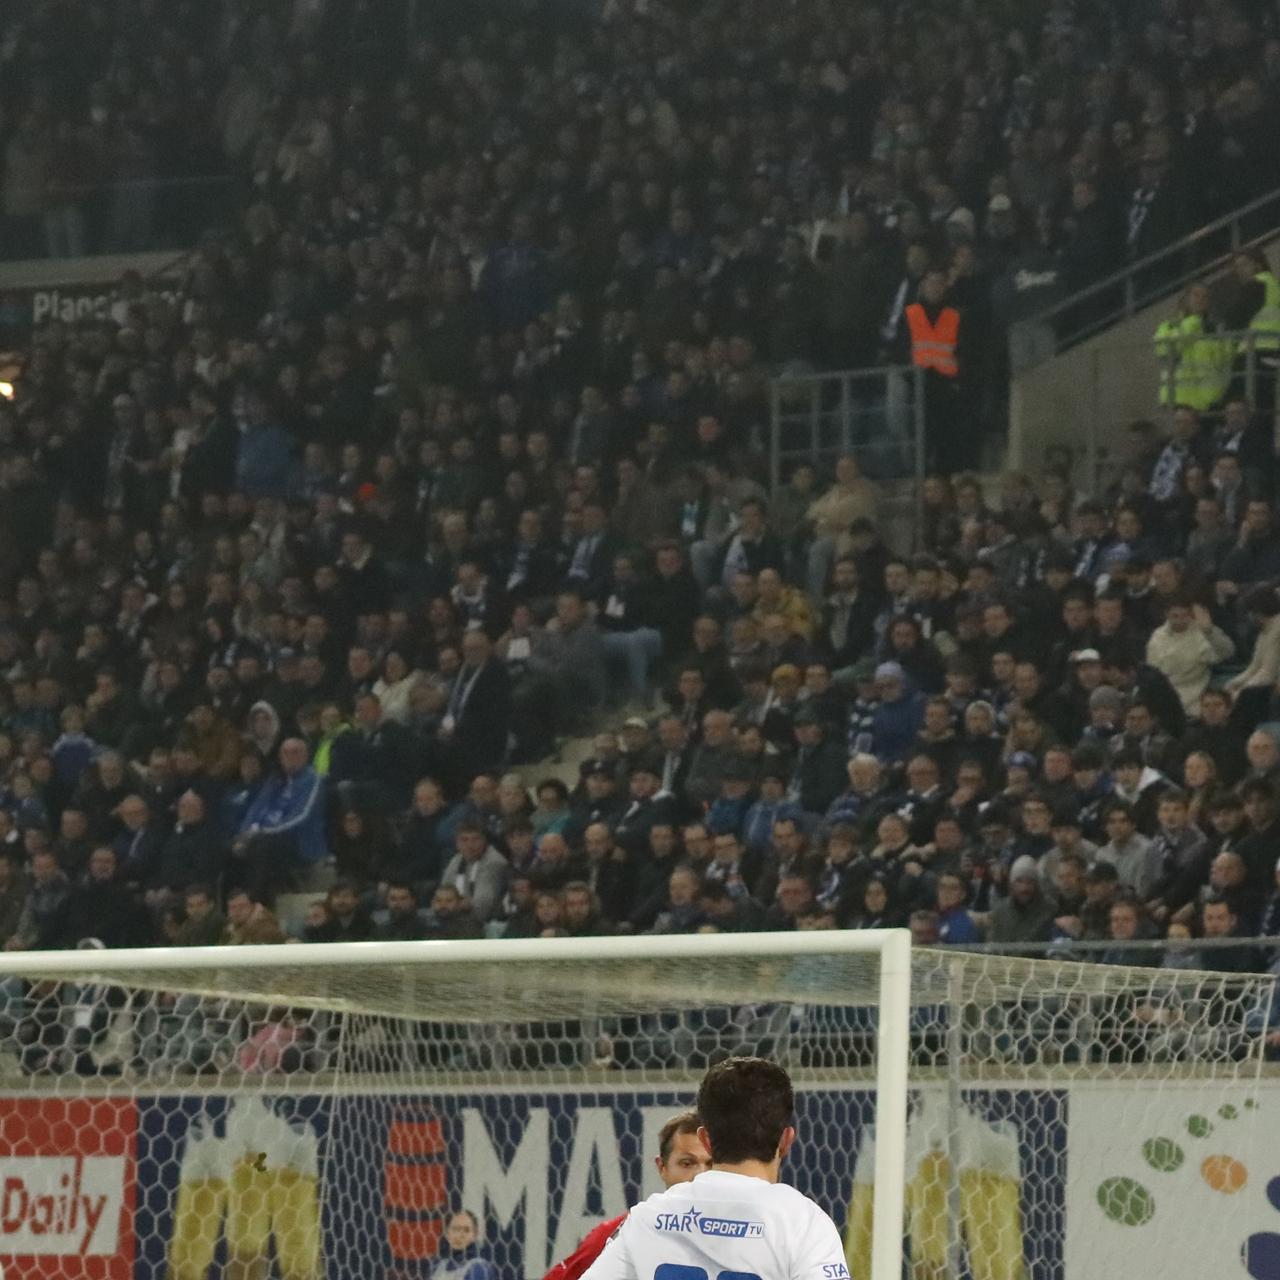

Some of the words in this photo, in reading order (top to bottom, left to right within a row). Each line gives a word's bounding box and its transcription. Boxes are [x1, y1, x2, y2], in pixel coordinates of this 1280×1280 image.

[1, 1157, 106, 1254] Daily
[463, 1107, 697, 1280] MA
[655, 1212, 693, 1233] STAR
[703, 1219, 745, 1236] SPORT
[749, 1224, 764, 1236] TV
[823, 1263, 851, 1279] STA
